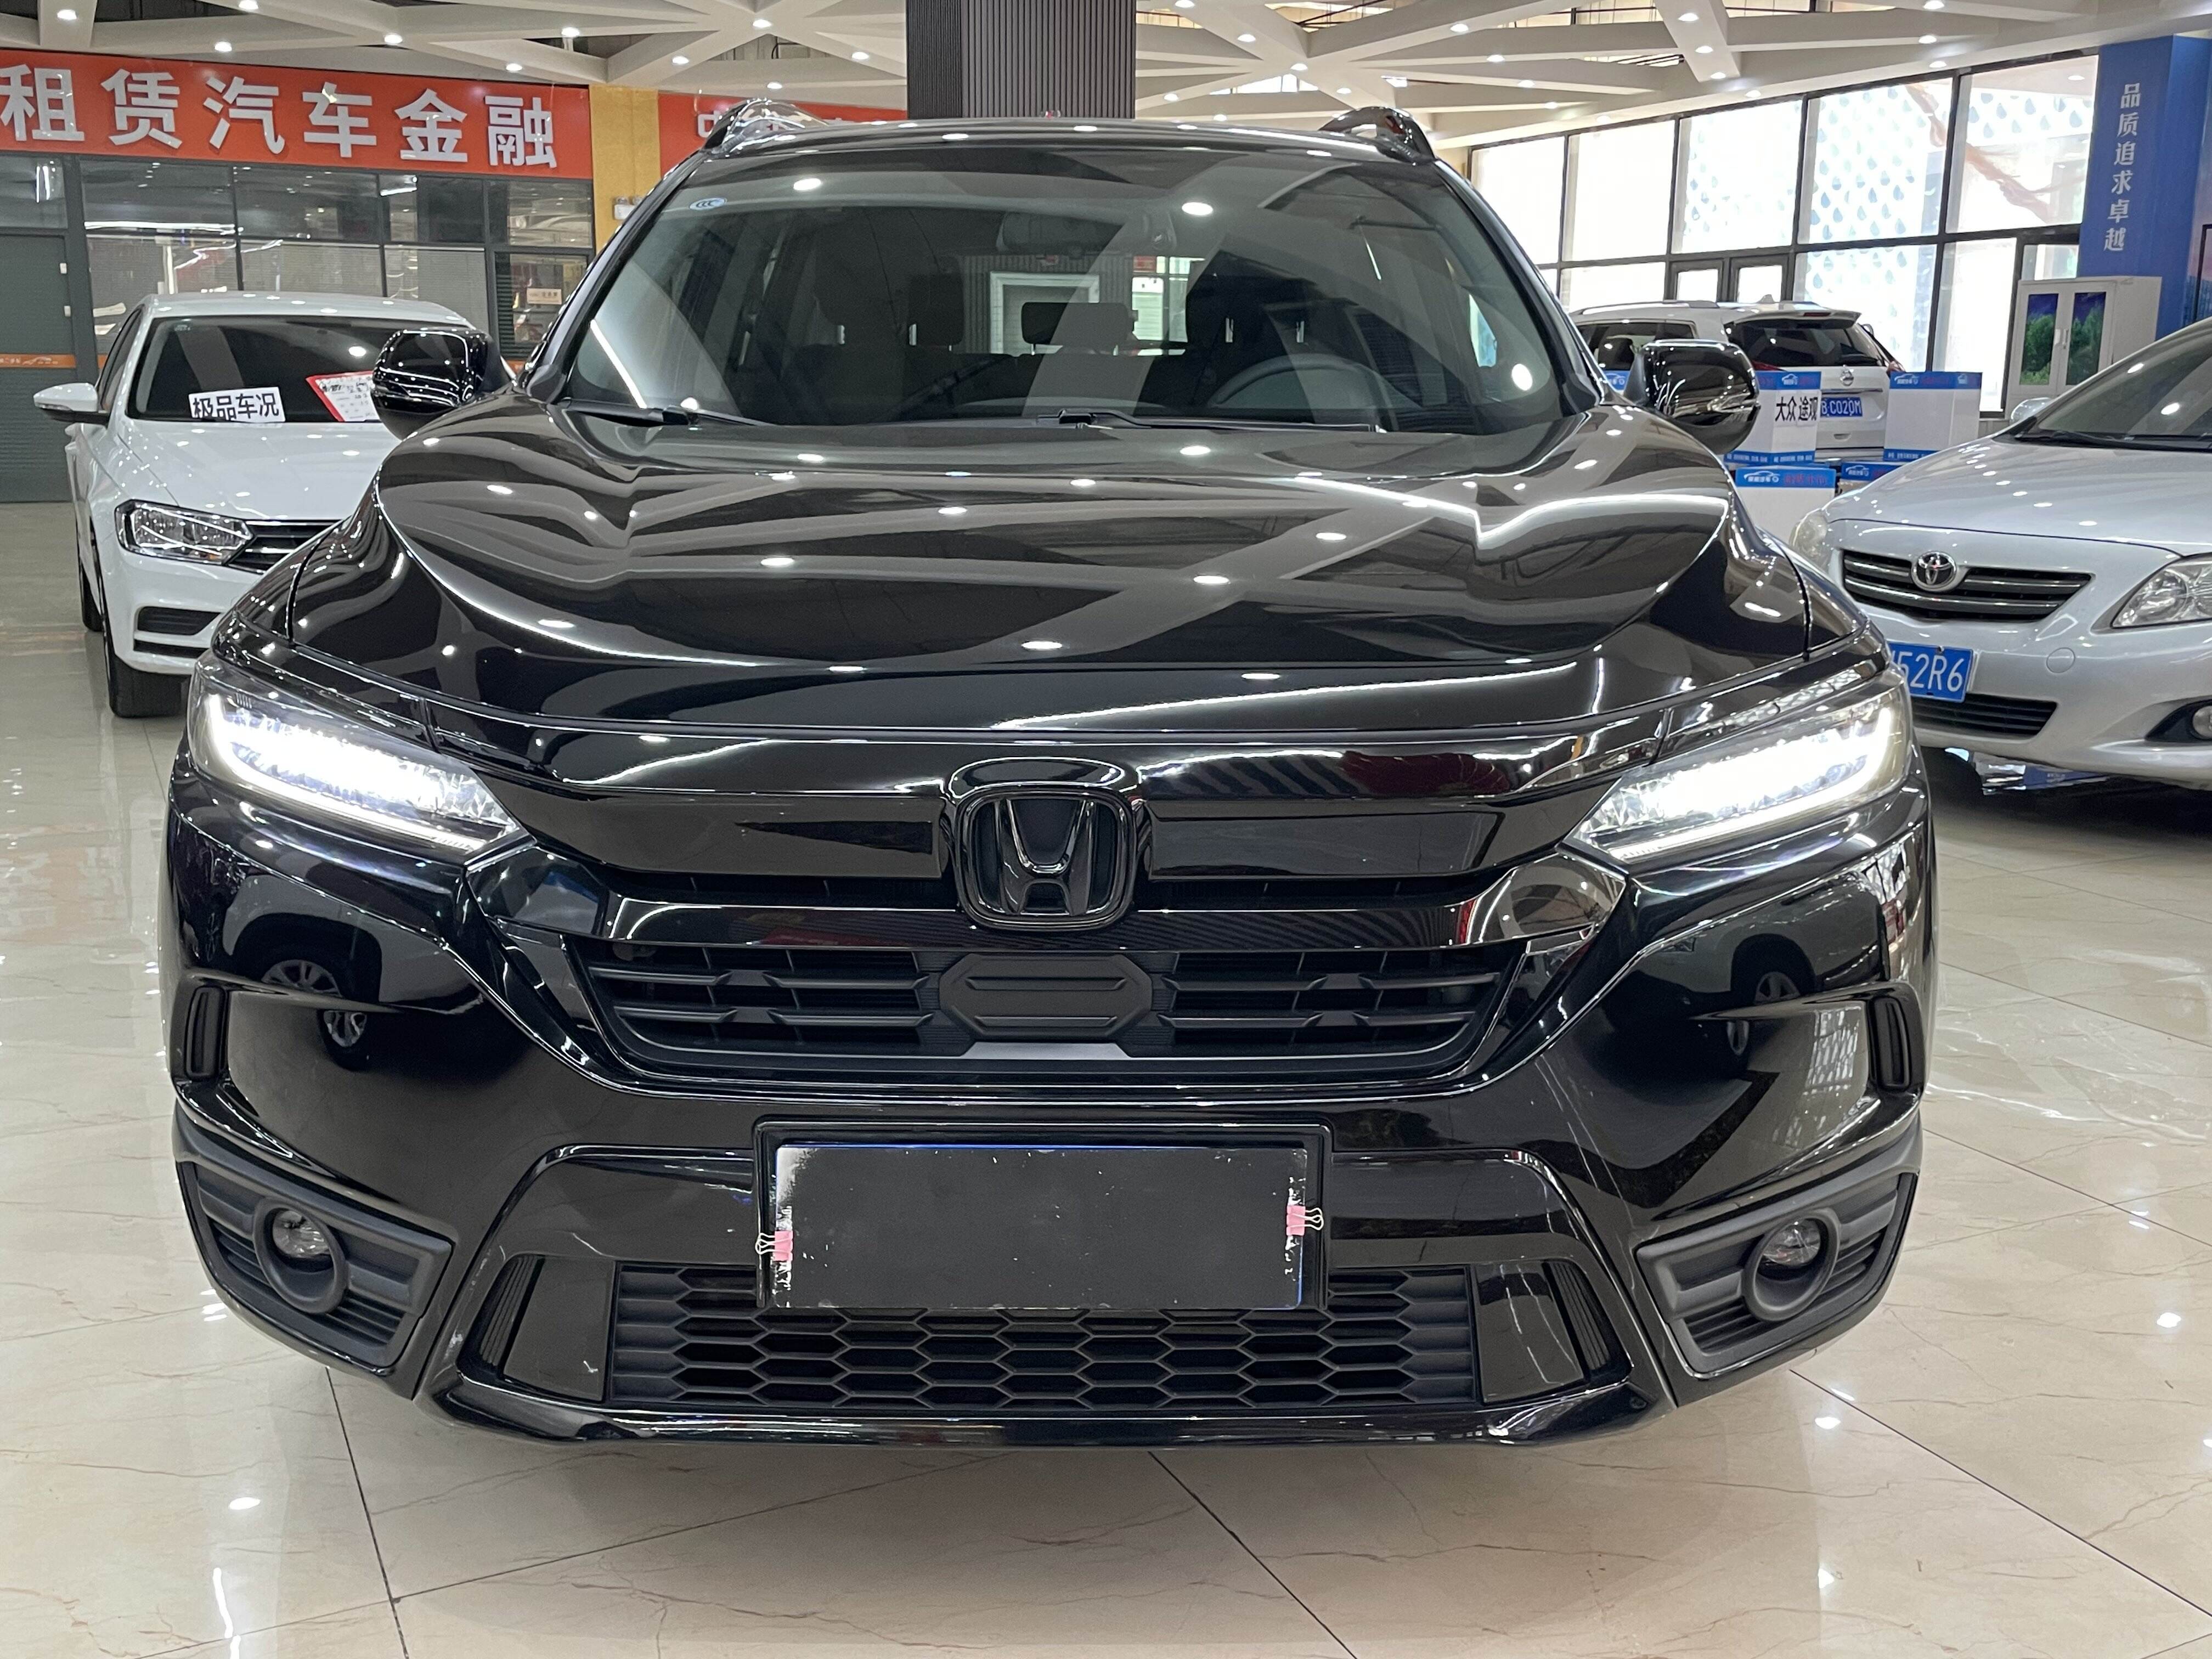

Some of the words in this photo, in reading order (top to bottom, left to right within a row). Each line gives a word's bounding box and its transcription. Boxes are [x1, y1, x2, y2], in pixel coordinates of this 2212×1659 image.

[0, 64, 557, 168] 租赁汽车金融
[2103, 83, 2140, 251] 品质追求卓越
[193, 393, 279, 421] 极品车况
[1893, 651, 1965, 692] 52R6
